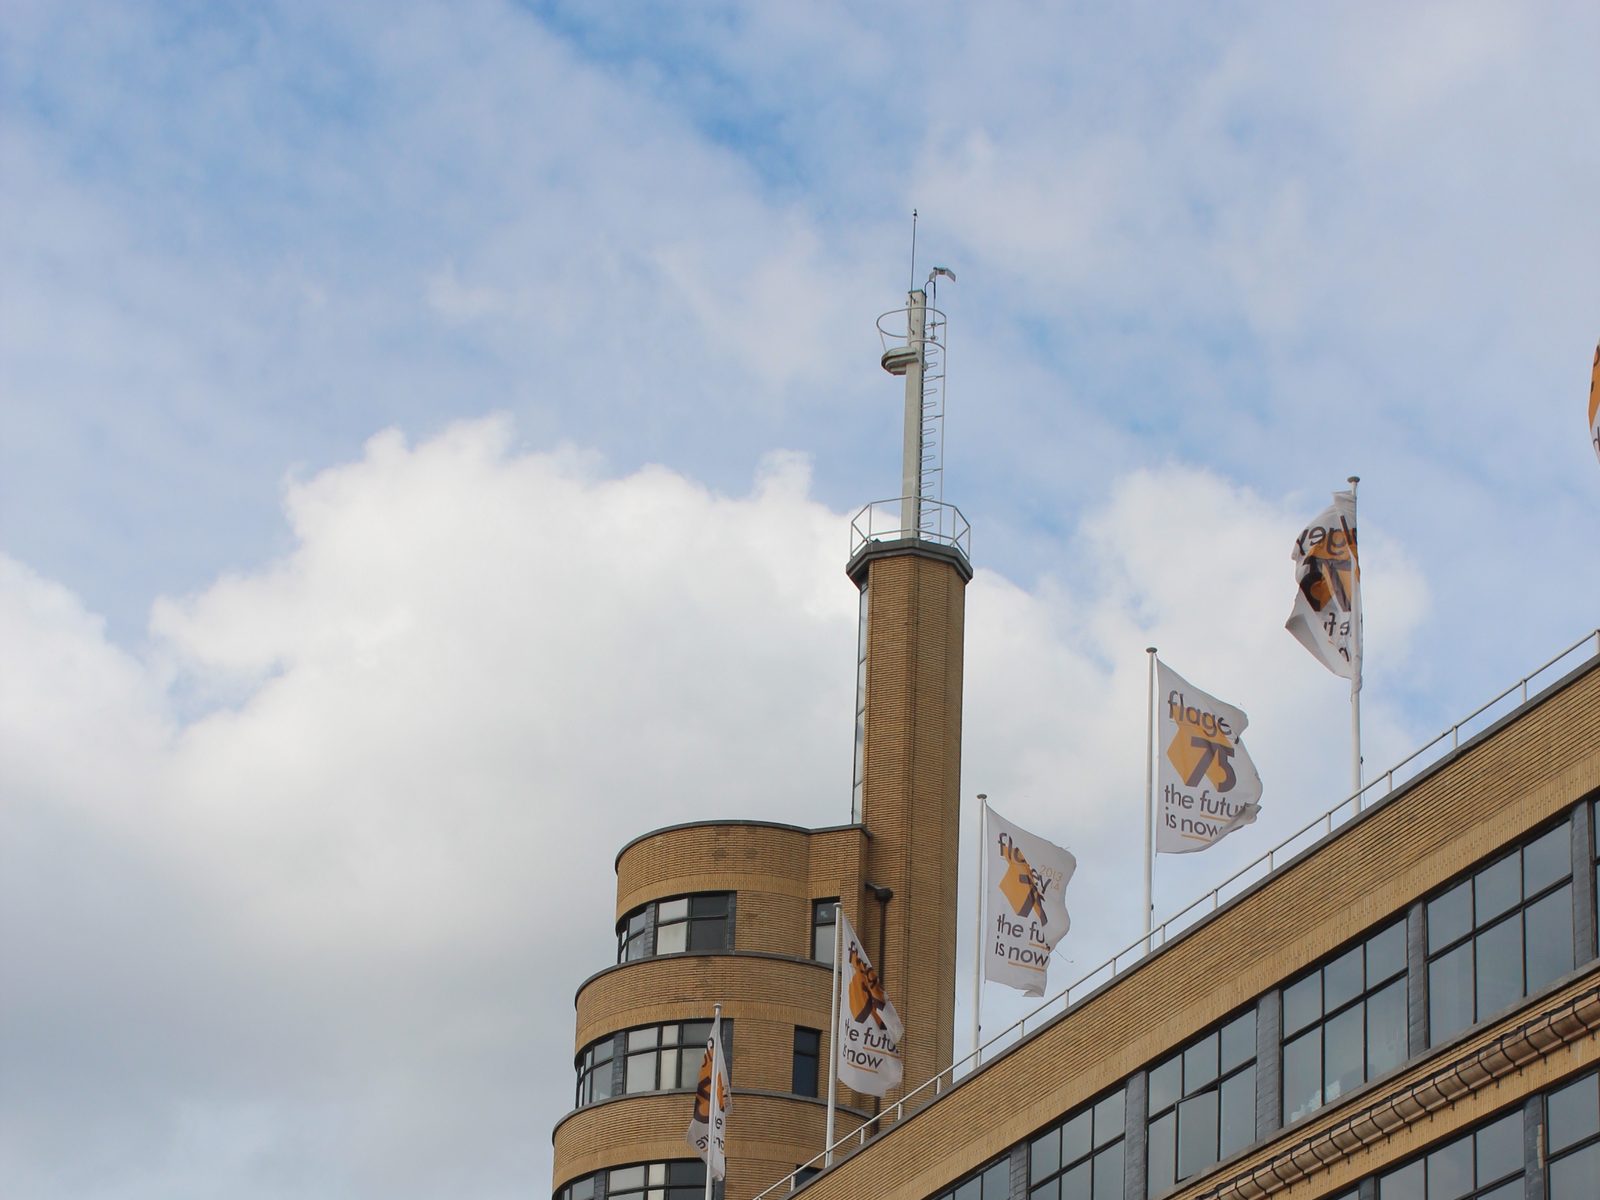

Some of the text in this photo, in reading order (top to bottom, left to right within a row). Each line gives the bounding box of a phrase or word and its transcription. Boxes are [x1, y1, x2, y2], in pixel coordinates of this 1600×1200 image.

[1191, 736, 1236, 793] 75
[1164, 783, 1194, 810] the
[1165, 807, 1177, 828] is
[997, 914, 1024, 938] the
[995, 935, 1005, 957] is
[1008, 946, 1049, 967] now
[847, 1048, 883, 1069] now
